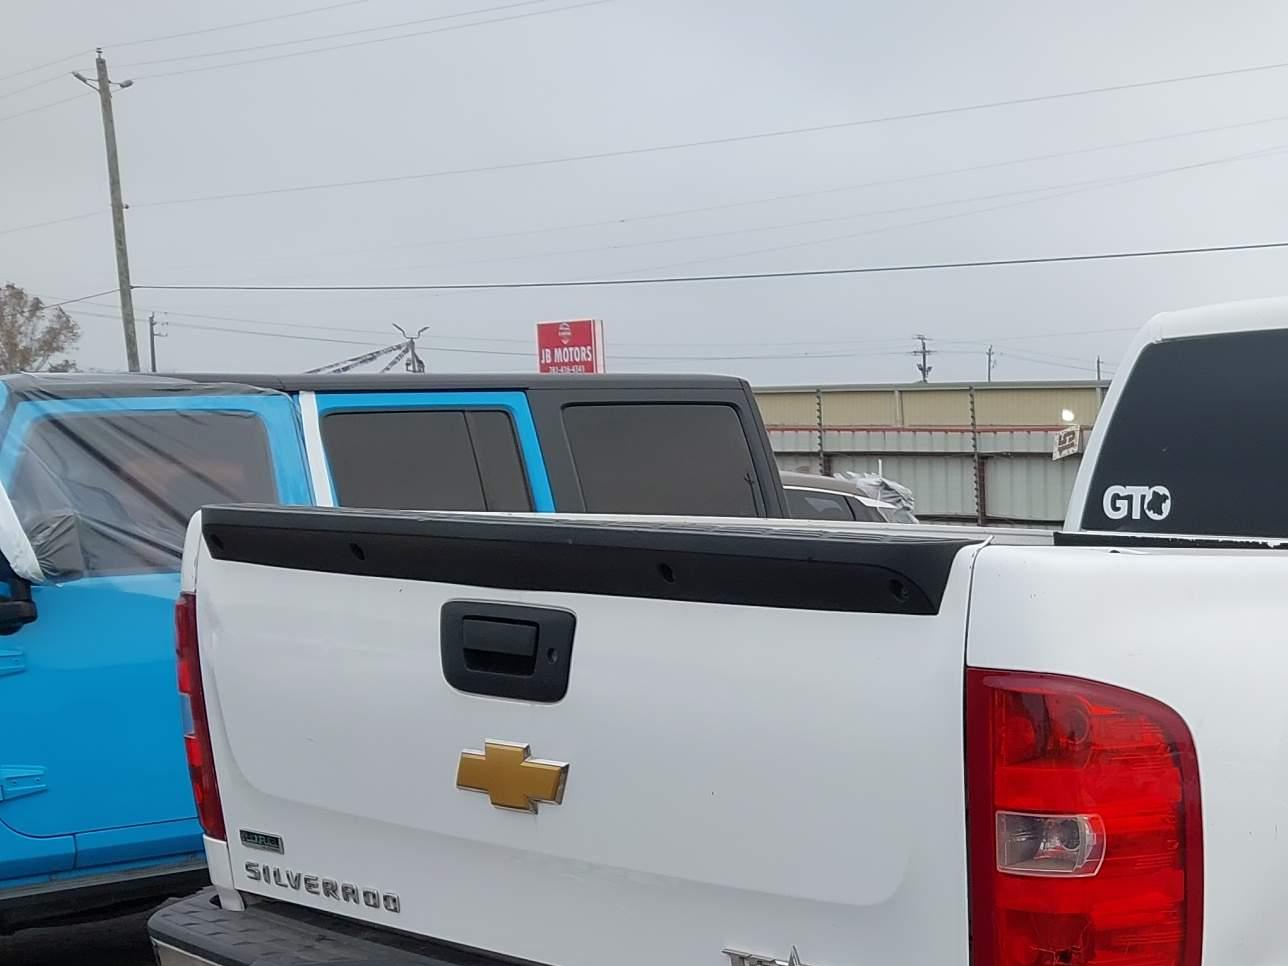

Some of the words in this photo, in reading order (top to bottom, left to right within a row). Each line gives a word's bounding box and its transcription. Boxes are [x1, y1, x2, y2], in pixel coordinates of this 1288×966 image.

[541, 348, 552, 364] JB
[554, 345, 593, 363] MOTORS
[1103, 484, 1171, 520] GTO
[245, 860, 401, 914] SILVERADO
